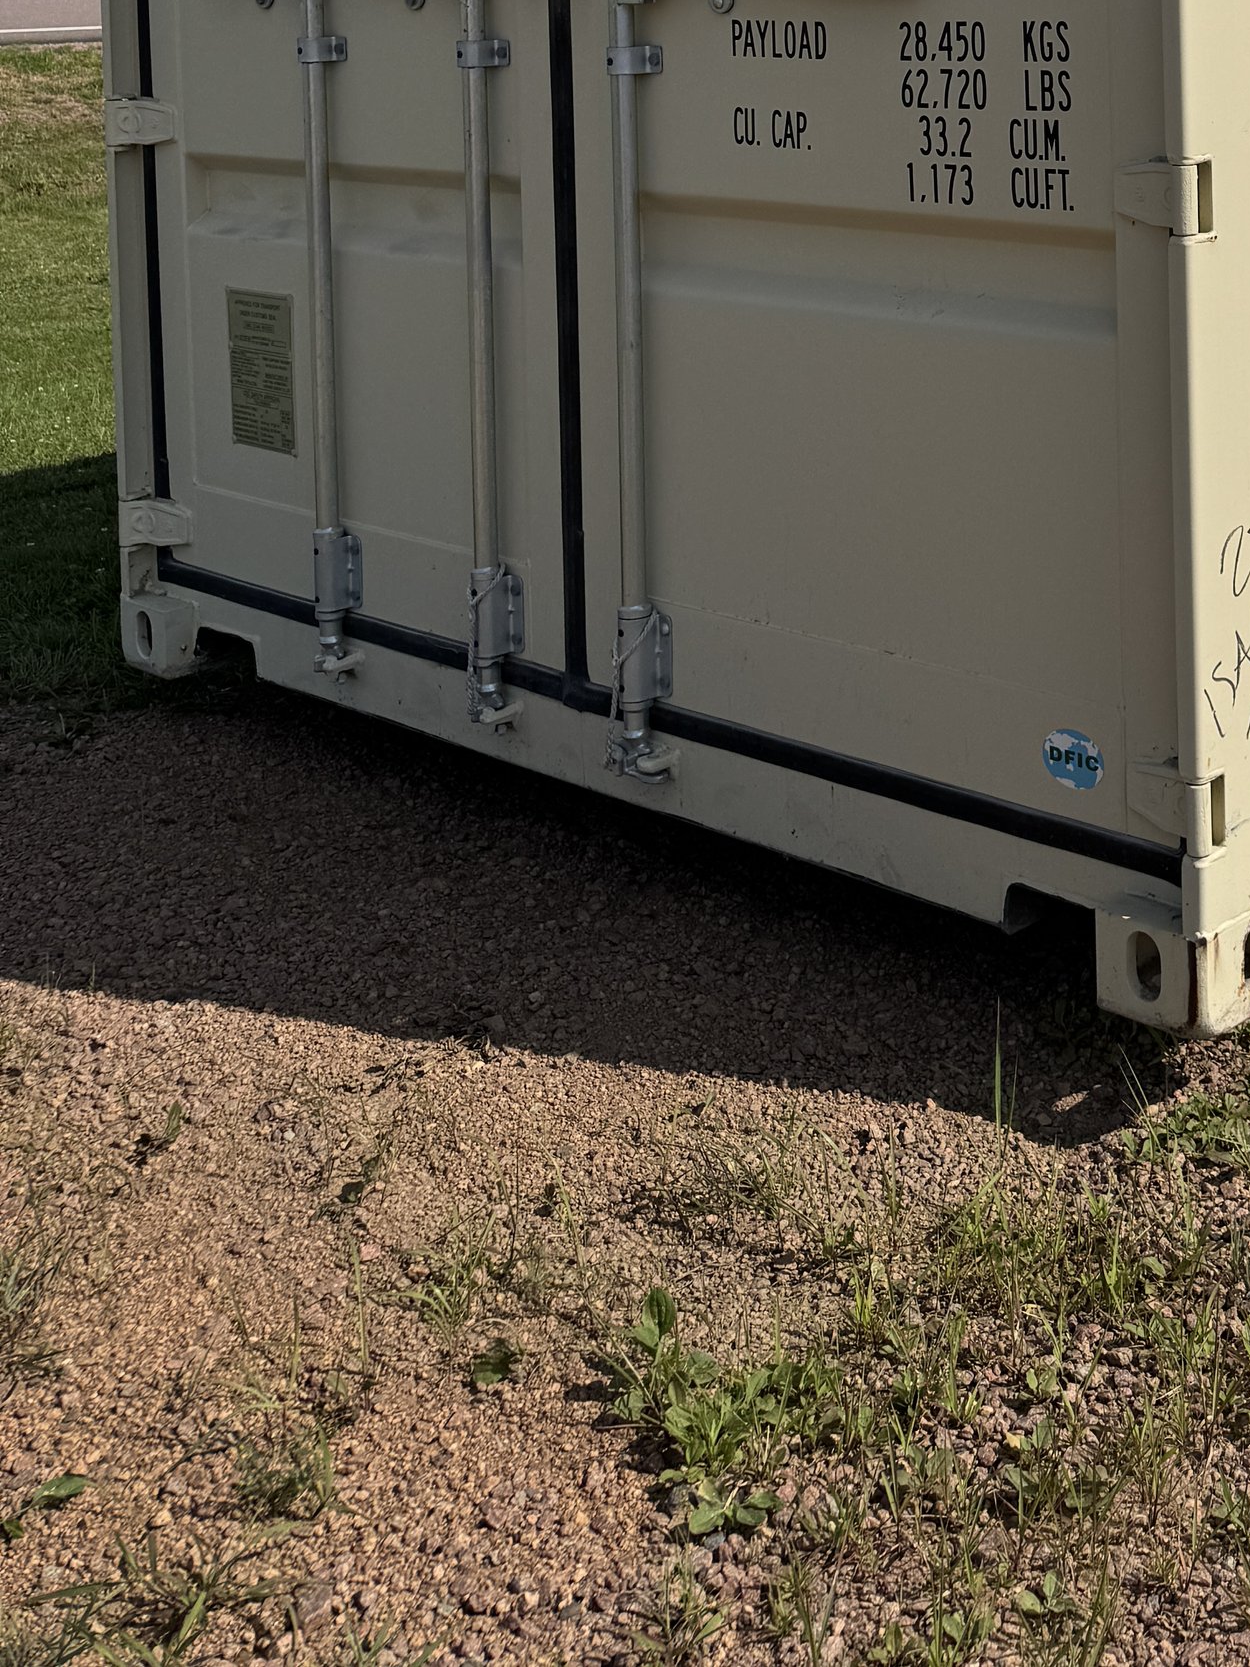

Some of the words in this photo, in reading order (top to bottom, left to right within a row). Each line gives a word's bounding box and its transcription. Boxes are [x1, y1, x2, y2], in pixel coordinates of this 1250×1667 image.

[731, 19, 827, 60] PAYLOAD
[899, 21, 986, 62] 28,450
[1022, 20, 1071, 63] KGS
[901, 68, 988, 111] 62,720
[1024, 69, 1073, 112] LBS
[733, 106, 761, 146] CU.
[771, 109, 813, 151] CAP.
[918, 115, 973, 158] 33.2
[1009, 118, 1067, 162] CU.M.
[906, 162, 975, 206] 1,173
[1010, 167, 1076, 212] CU.FT.
[1049, 745, 1100, 772] DFIC
